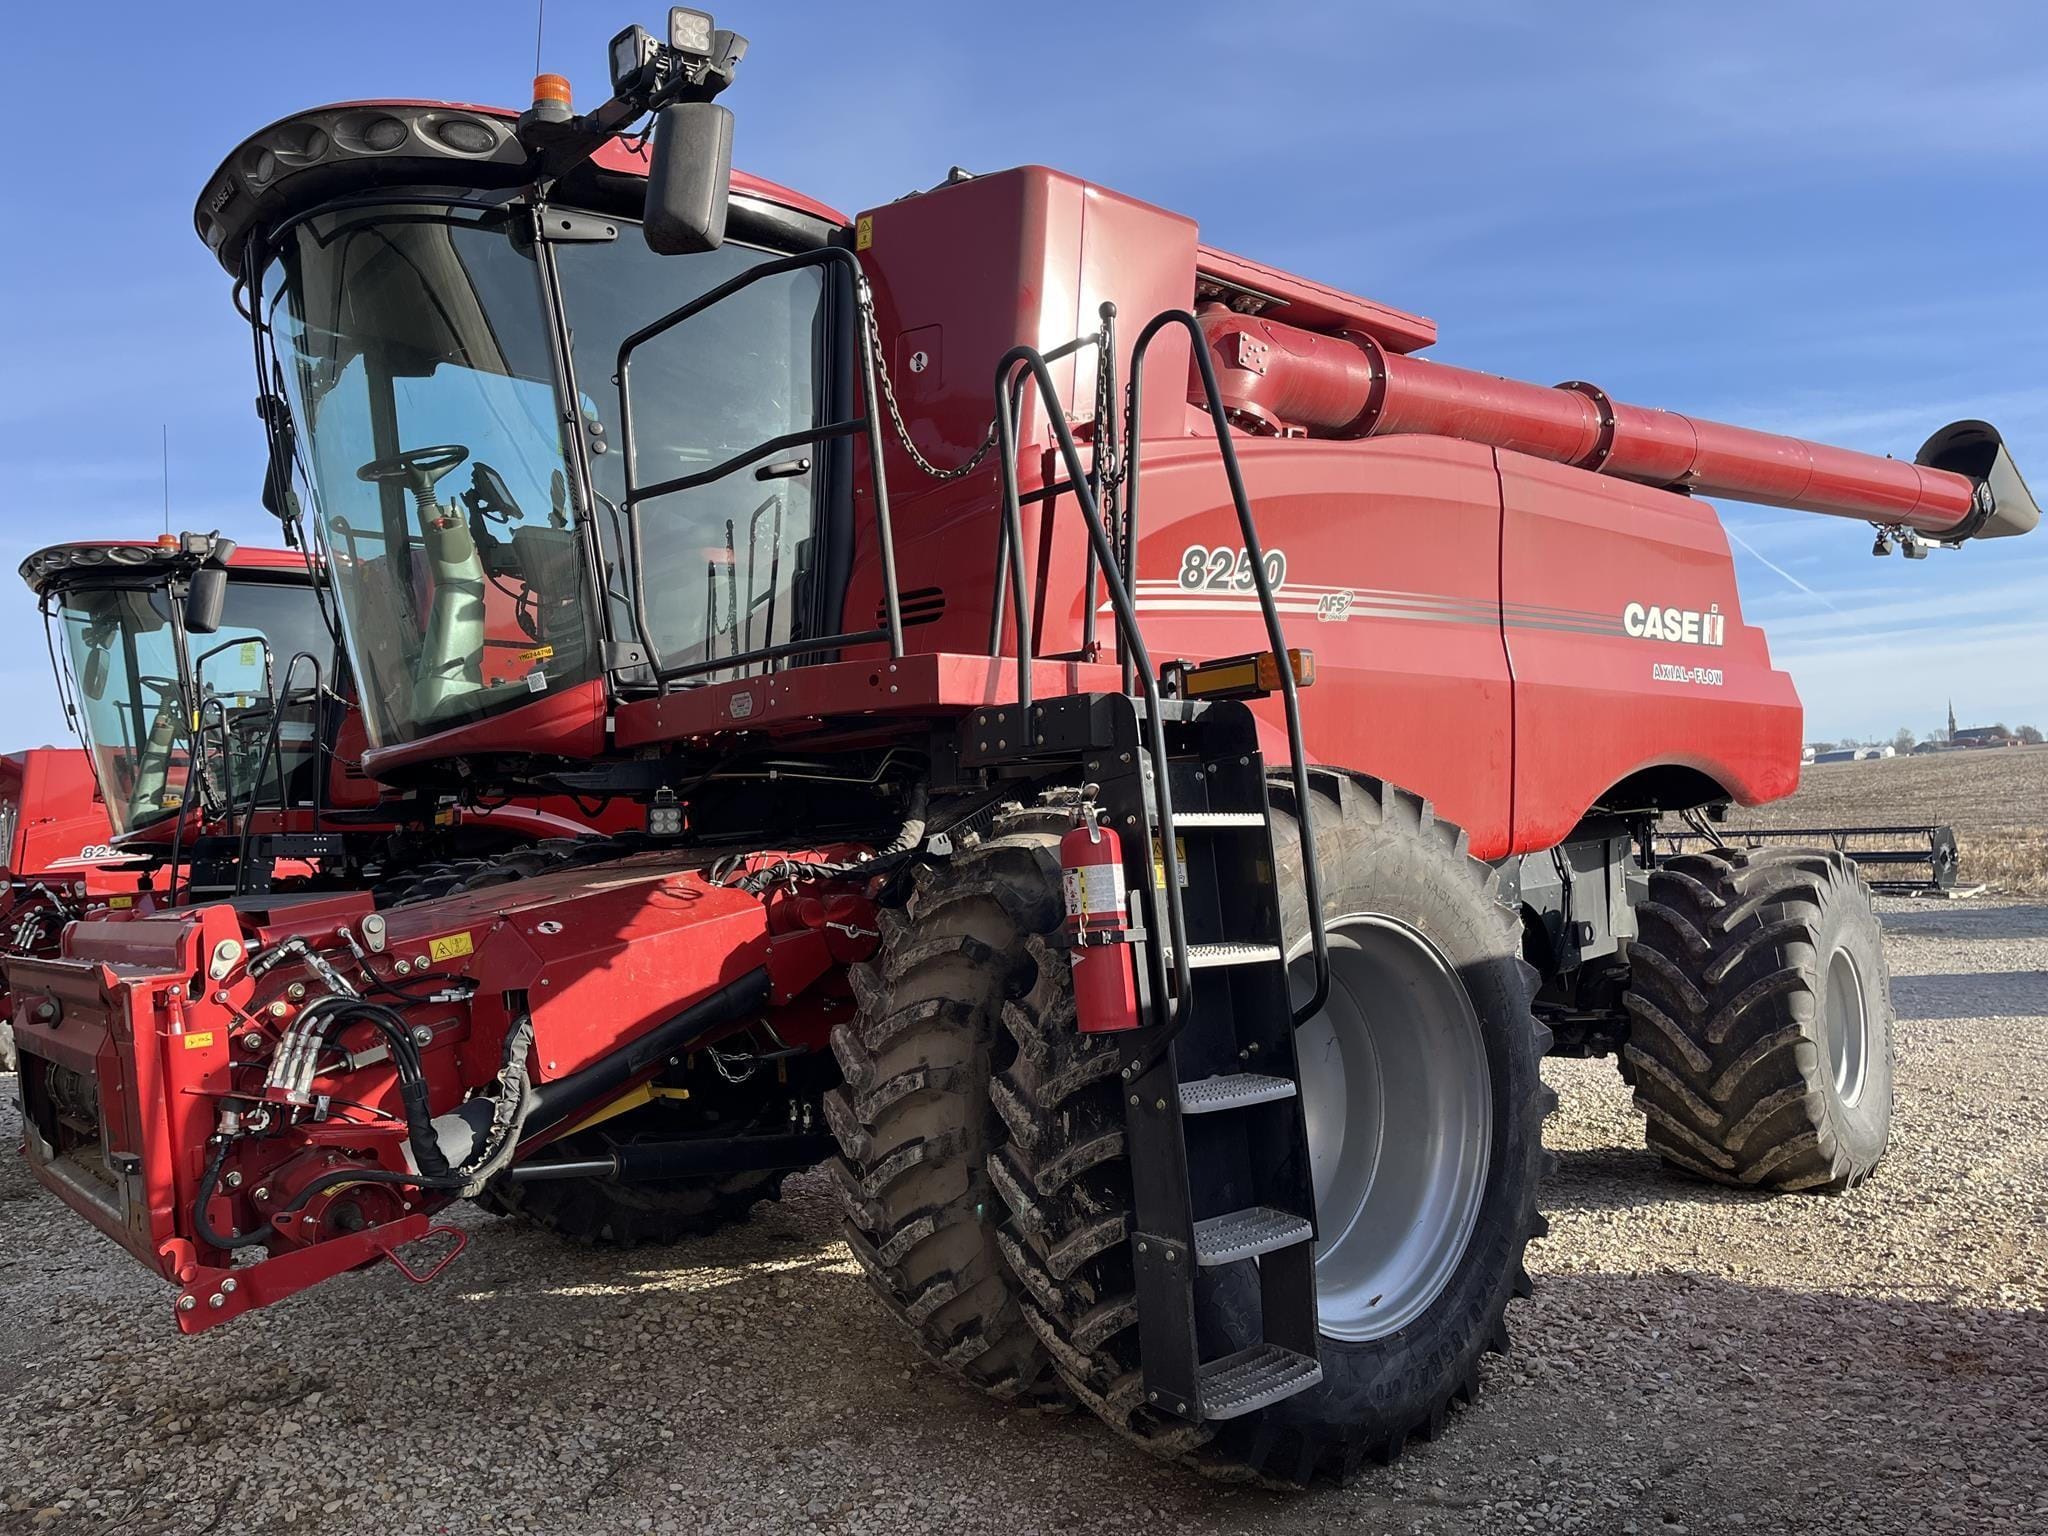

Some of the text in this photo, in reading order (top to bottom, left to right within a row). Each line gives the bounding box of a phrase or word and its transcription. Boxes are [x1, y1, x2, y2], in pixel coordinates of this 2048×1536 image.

[212, 191, 229, 213] CASE
[1318, 595, 1346, 611] AFS
[1624, 602, 1700, 643] CASE
[1653, 663, 1723, 686] AXIAL-FLOW
[81, 845, 124, 859] 825
